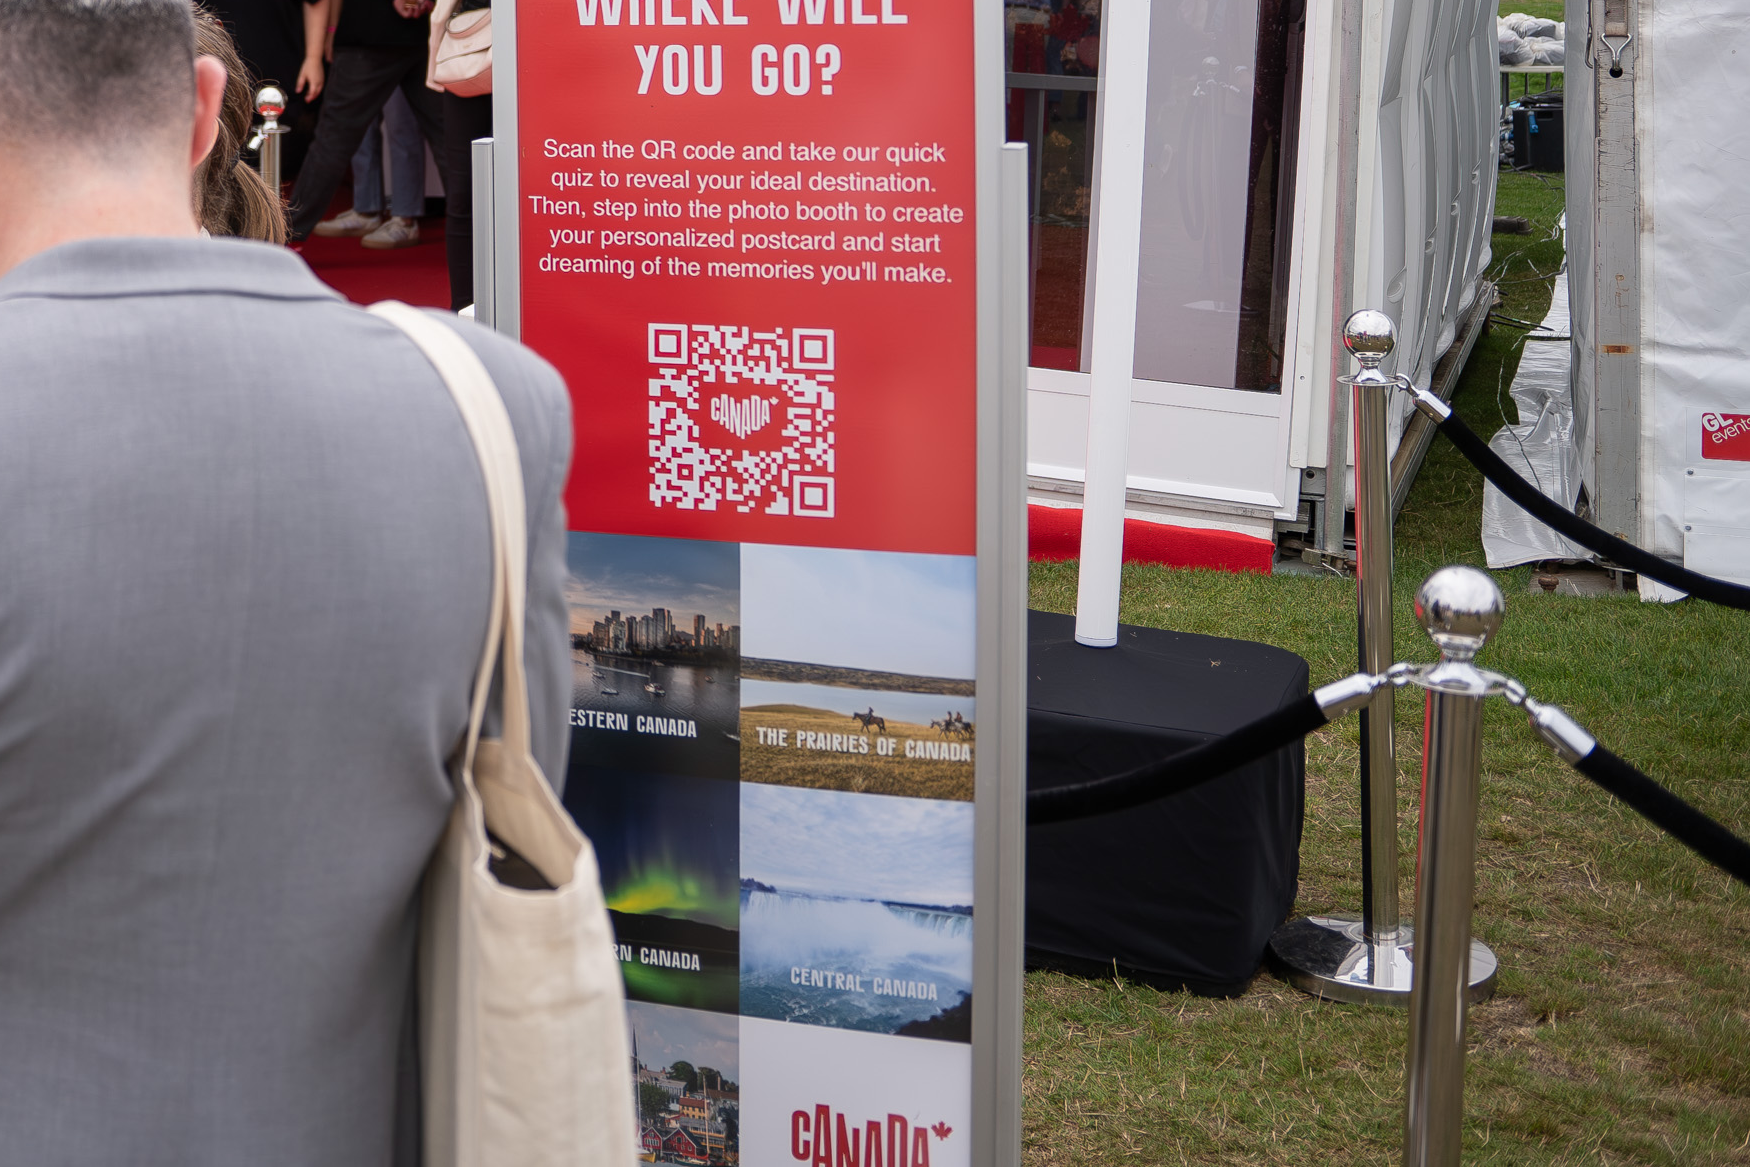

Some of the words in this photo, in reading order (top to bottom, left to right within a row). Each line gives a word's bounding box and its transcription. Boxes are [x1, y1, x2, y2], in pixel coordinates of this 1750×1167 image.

[634, 45, 723, 95] YOU
[751, 44, 842, 95] GO?
[544, 139, 596, 160] Scan
[602, 140, 634, 160] the
[641, 140, 676, 161] QR
[683, 141, 735, 161] code
[742, 141, 782, 161] and
[789, 142, 836, 162] take
[842, 146, 880, 162] our
[886, 143, 946, 166] quick
[551, 169, 593, 191] quiz
[599, 171, 620, 188] to
[626, 170, 690, 190] reveal
[696, 174, 744, 194] your
[751, 172, 802, 191] ideal
[808, 173, 936, 193] destination.
[528, 196, 586, 219] Then,
[593, 199, 637, 221] step
[644, 198, 682, 218] into
[688, 200, 721, 219] the
[728, 200, 789, 223] photo
[796, 201, 858, 221] booth
[864, 205, 886, 222] to
[892, 204, 964, 223] create
[549, 229, 594, 248] your
[600, 228, 735, 249] personalized
[741, 230, 835, 253] postcard
[842, 232, 883, 252] and
[890, 233, 940, 253] start
[539, 253, 635, 279] dreaming
[641, 257, 662, 276] of
[667, 257, 701, 276] the
[707, 258, 814, 280] memories
[821, 261, 877, 285] you'll
[884, 264, 952, 283] make.
[710, 393, 771, 440] CANADA
[1702, 412, 1734, 432] GL
[636, 715, 697, 738] CANADA
[756, 726, 788, 747] THE
[797, 730, 869, 754] PRAIRIES
[877, 737, 897, 756] OF
[905, 739, 971, 762] CANADA
[640, 947, 700, 972] CANADA
[790, 967, 865, 993] CENTRAL
[873, 977, 938, 1001] CANADA
[791, 1103, 930, 1167] CANADA
